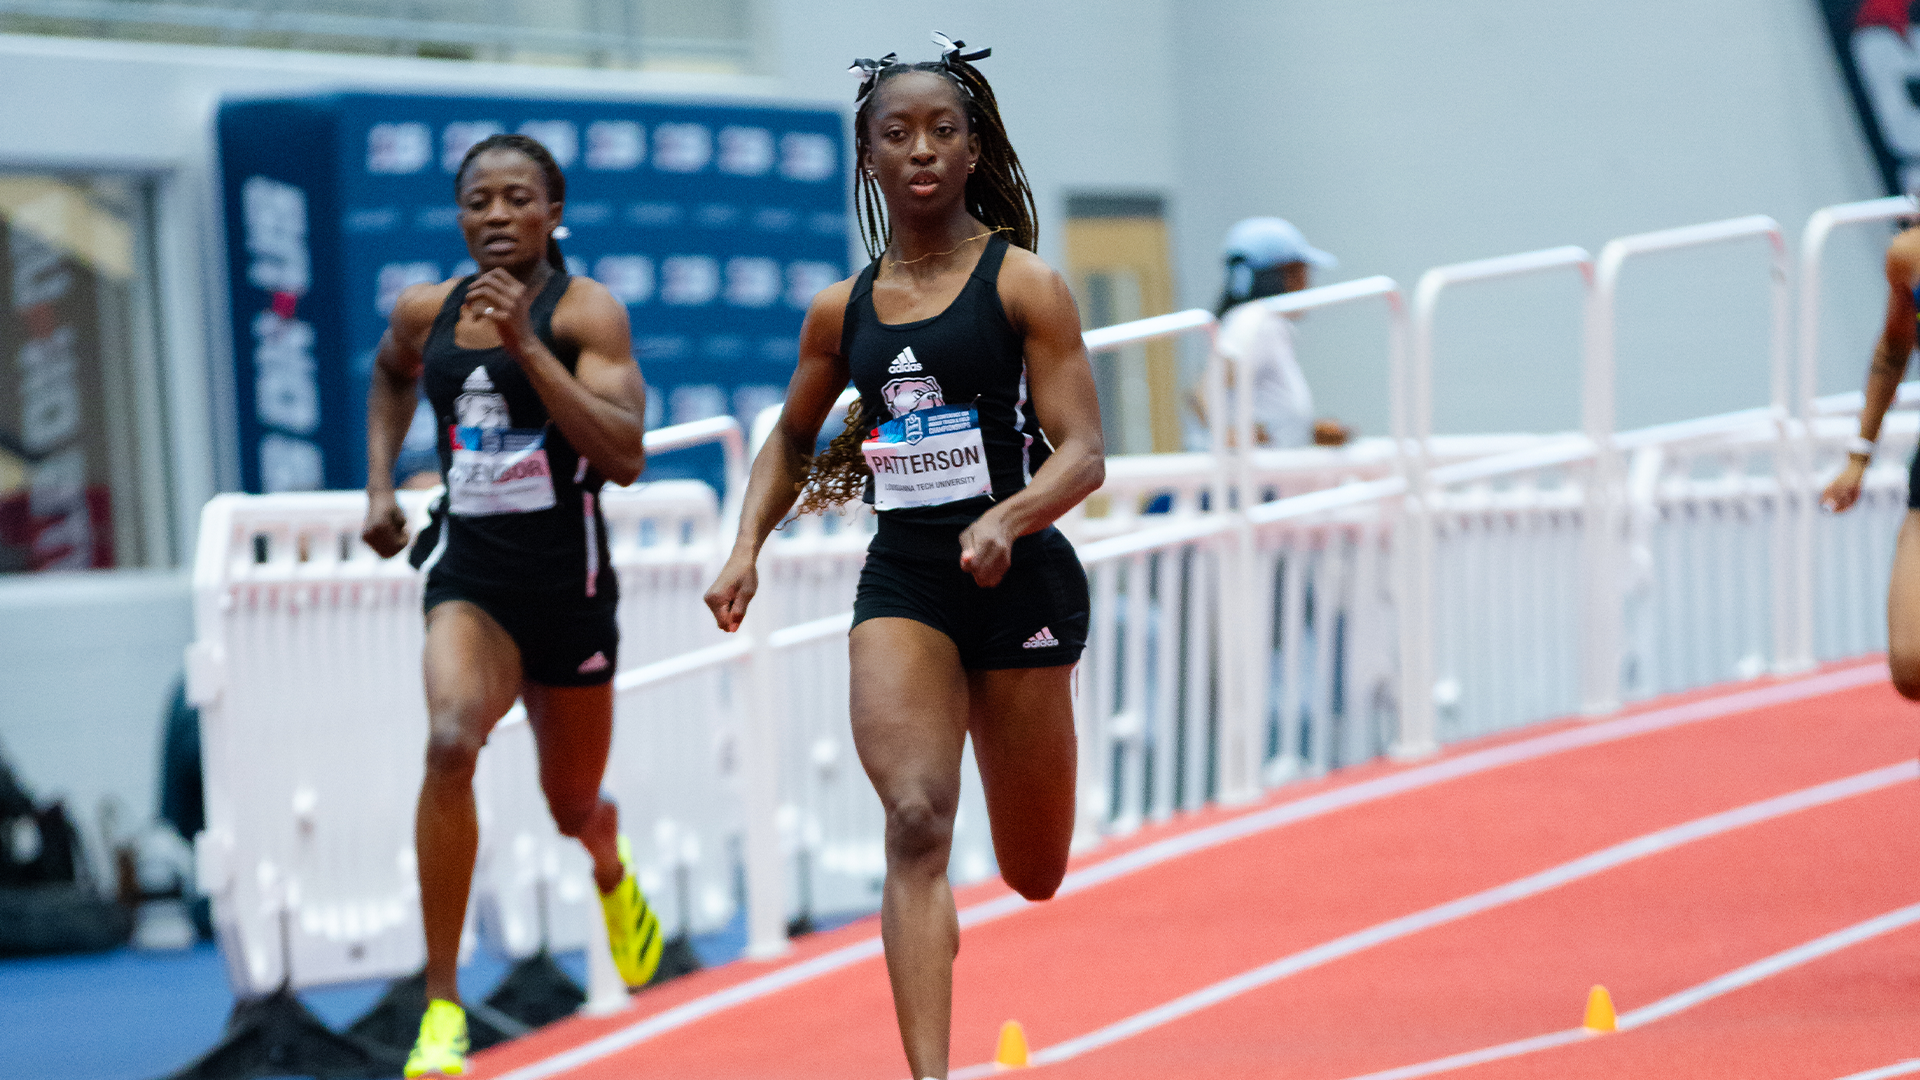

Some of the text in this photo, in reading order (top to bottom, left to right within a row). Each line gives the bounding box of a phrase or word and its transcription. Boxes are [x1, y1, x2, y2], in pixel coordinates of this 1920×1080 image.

[888, 363, 923, 374] adidas
[871, 445, 980, 475] PATTERSON
[917, 481, 935, 491] TECH
[936, 476, 976, 489] UNIVERSITY
[1022, 639, 1059, 649] adidas
